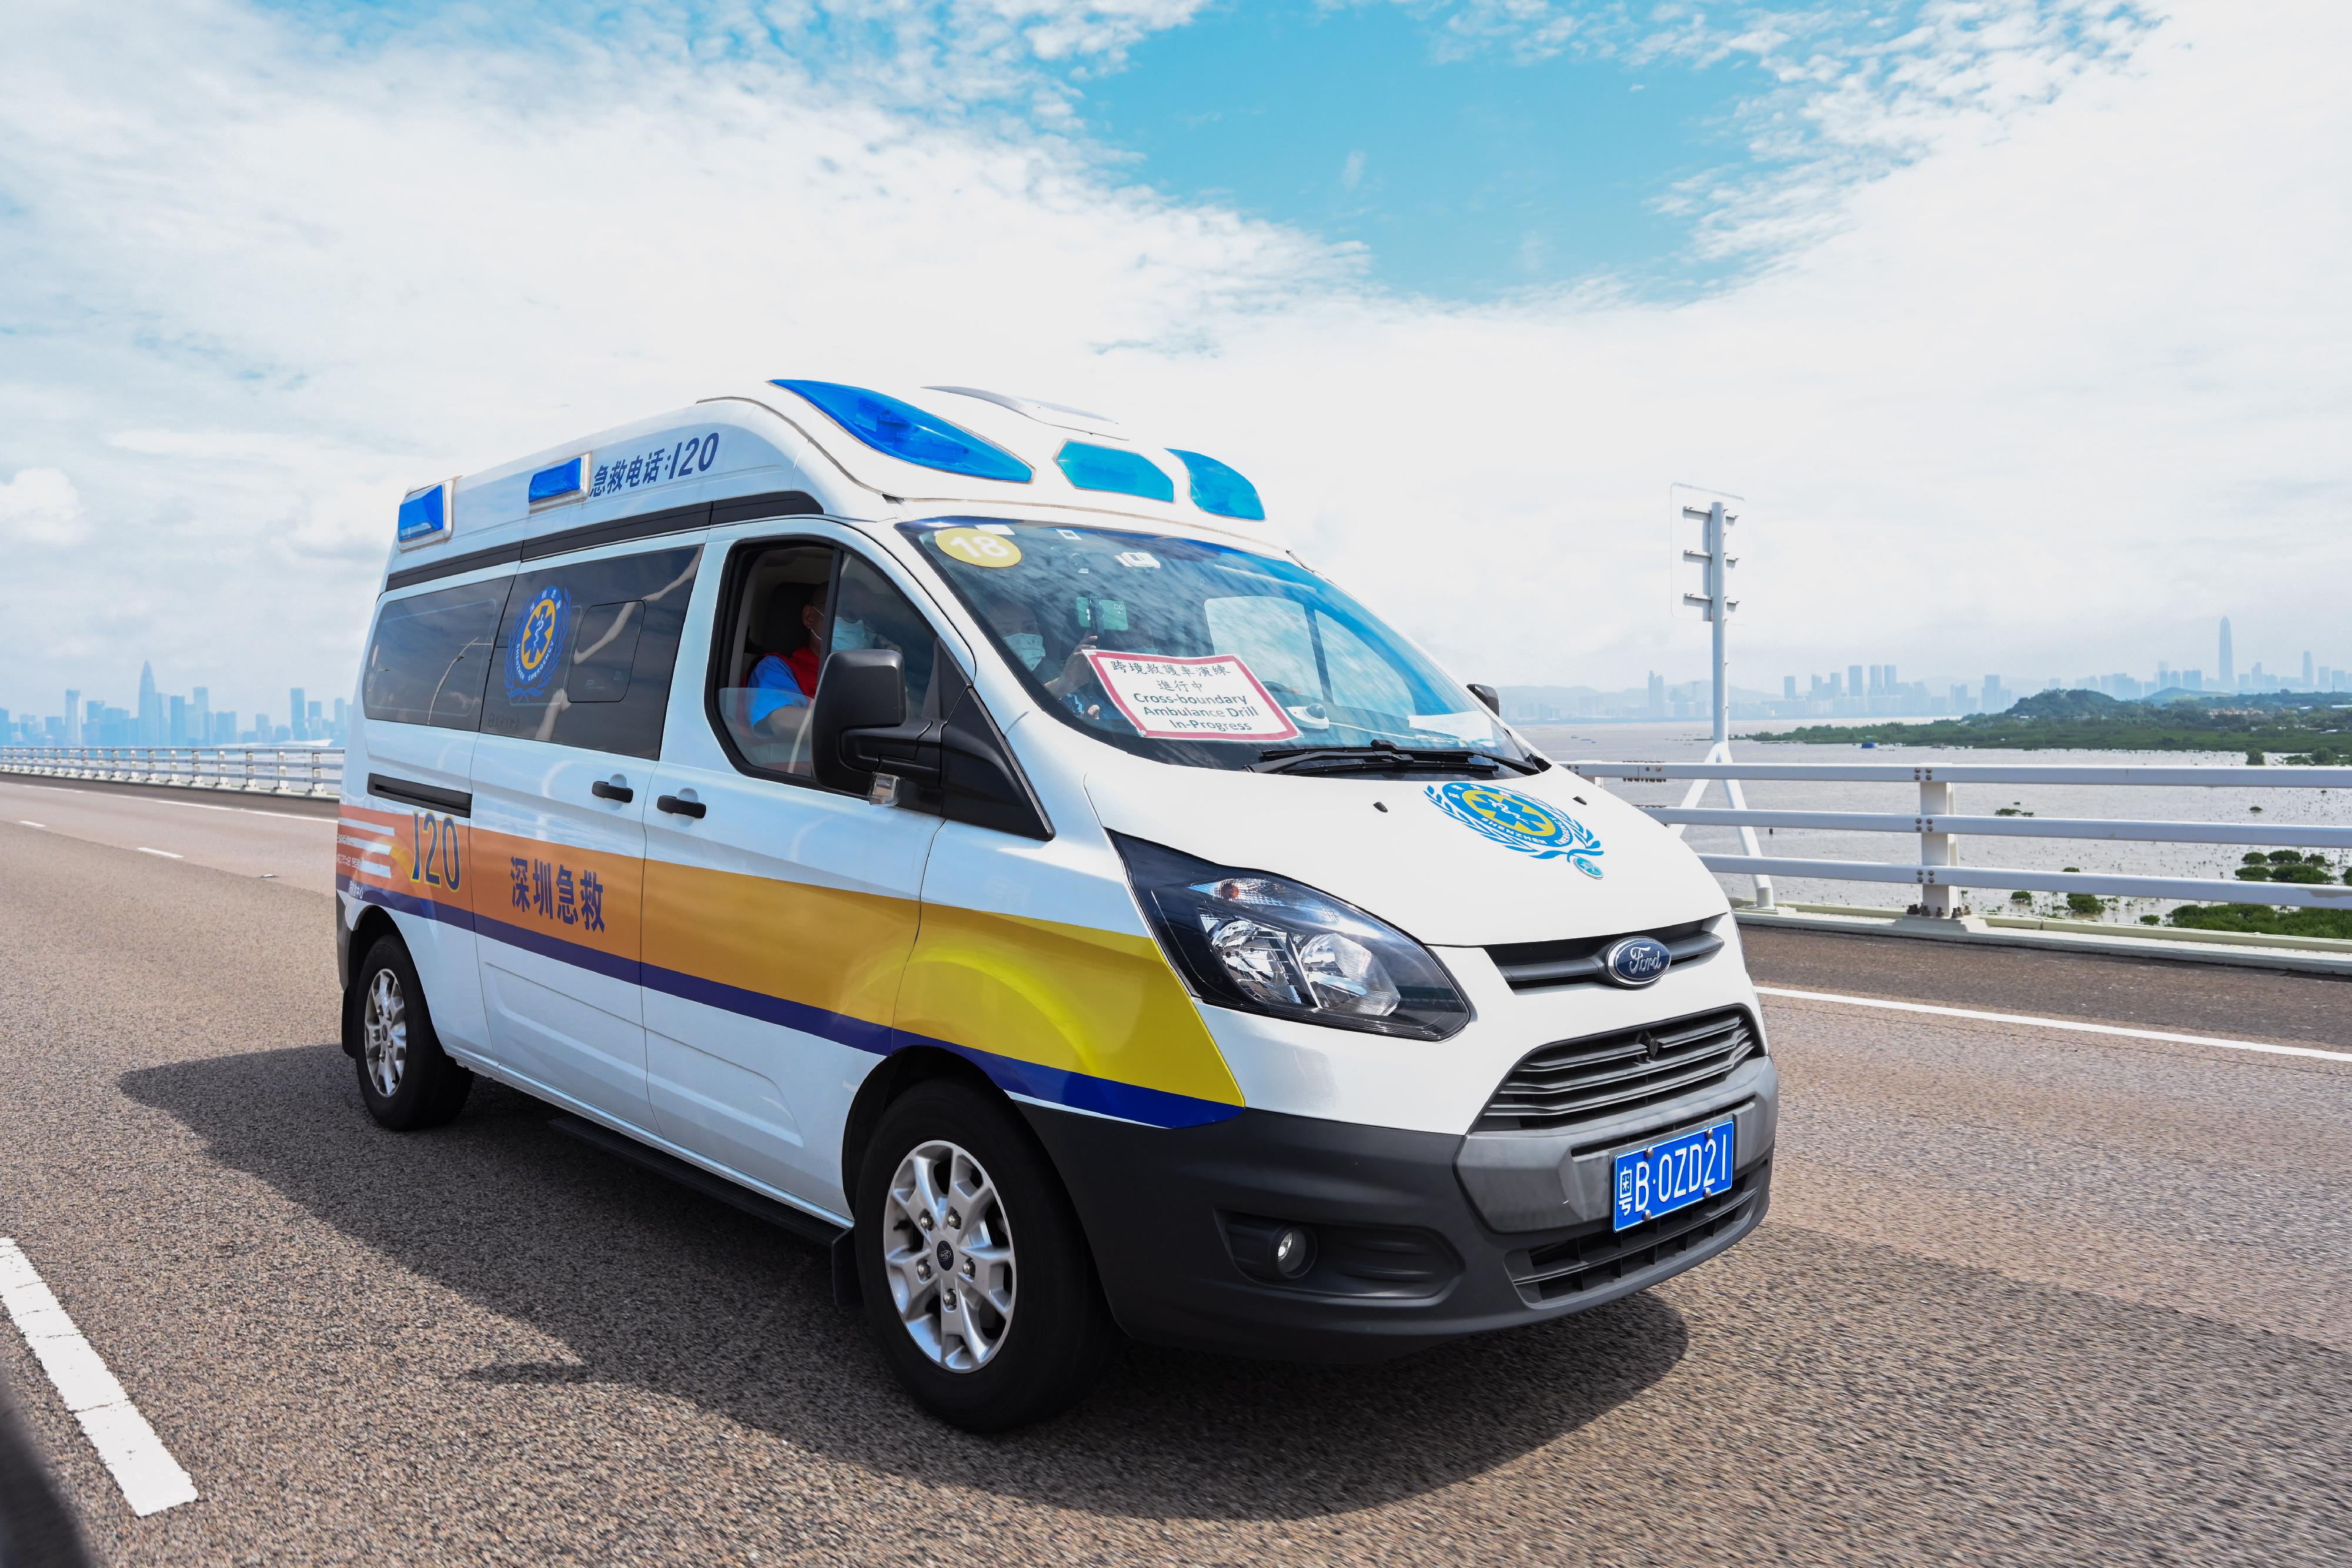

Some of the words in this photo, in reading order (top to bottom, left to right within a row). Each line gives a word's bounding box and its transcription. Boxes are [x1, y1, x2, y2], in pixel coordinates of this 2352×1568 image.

[950, 536, 1010, 559] 18
[528, 640, 554, 681] EMERGENCY
[1111, 660, 1231, 678] 跨境救護車演練
[1156, 680, 1203, 693] 進行中
[1133, 692, 1248, 706] Cross-boundary
[1143, 706, 1225, 718] Ambulance
[1229, 706, 1259, 717] Drill
[1169, 719, 1252, 732] In-Progress
[1481, 817, 1548, 845] SHENZHEN
[411, 810, 460, 893] 120
[510, 855, 605, 934] 深圳急救
[1629, 946, 1662, 974] Ford
